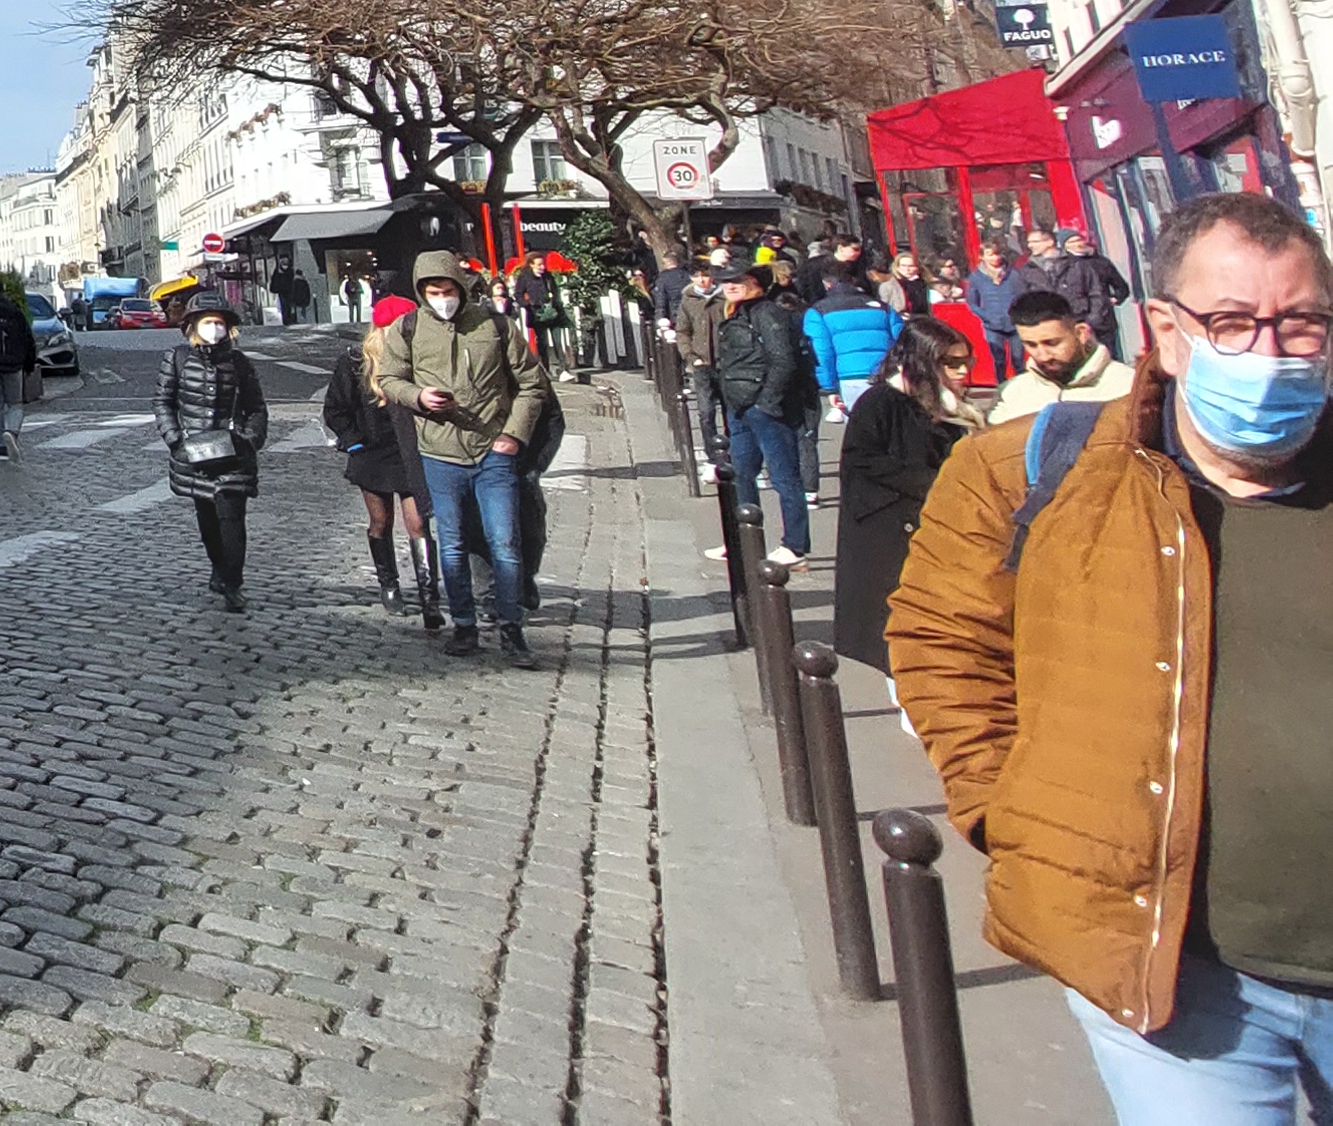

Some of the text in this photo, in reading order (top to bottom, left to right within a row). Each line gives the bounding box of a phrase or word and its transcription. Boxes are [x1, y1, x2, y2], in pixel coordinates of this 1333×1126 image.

[1003, 29, 1051, 42] FAGUO
[1142, 50, 1226, 68] HORACE
[663, 145, 696, 155] ZONE
[673, 170, 692, 182] 30
[520, 221, 566, 235] beauty
